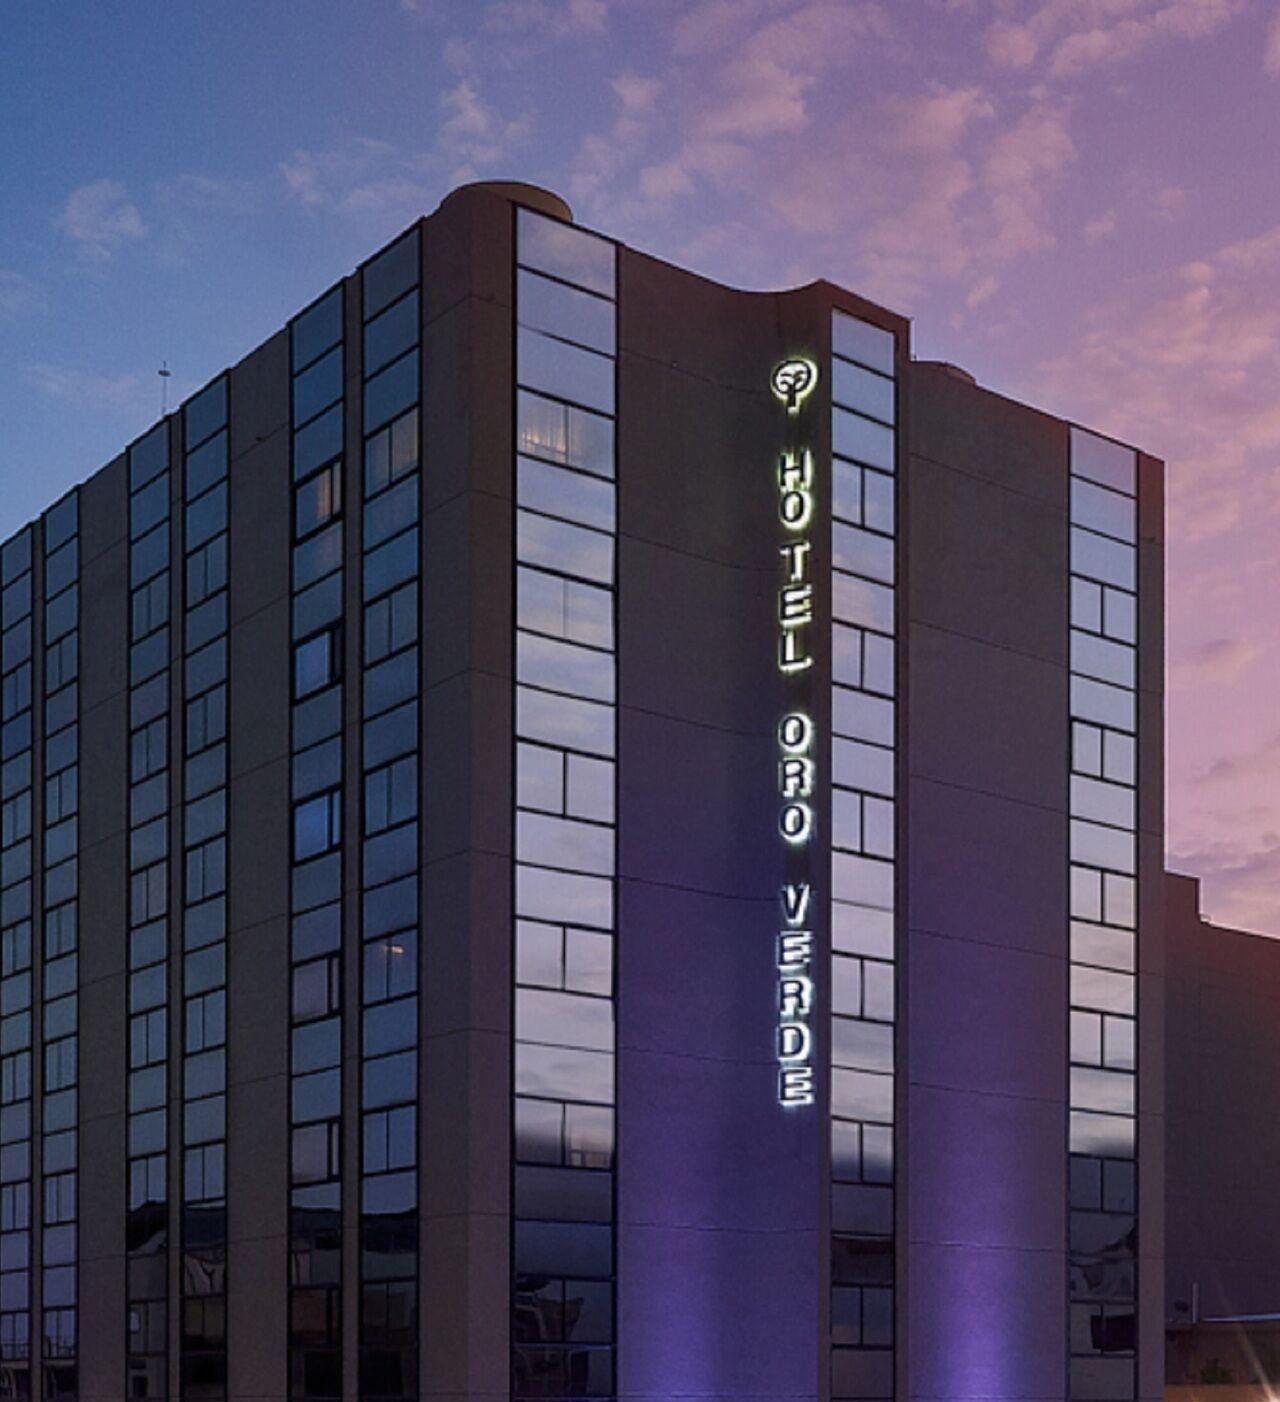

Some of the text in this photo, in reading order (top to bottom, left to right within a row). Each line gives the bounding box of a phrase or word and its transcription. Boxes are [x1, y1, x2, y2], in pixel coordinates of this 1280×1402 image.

[776, 447, 815, 1107] HOTEL ORO VERDE
